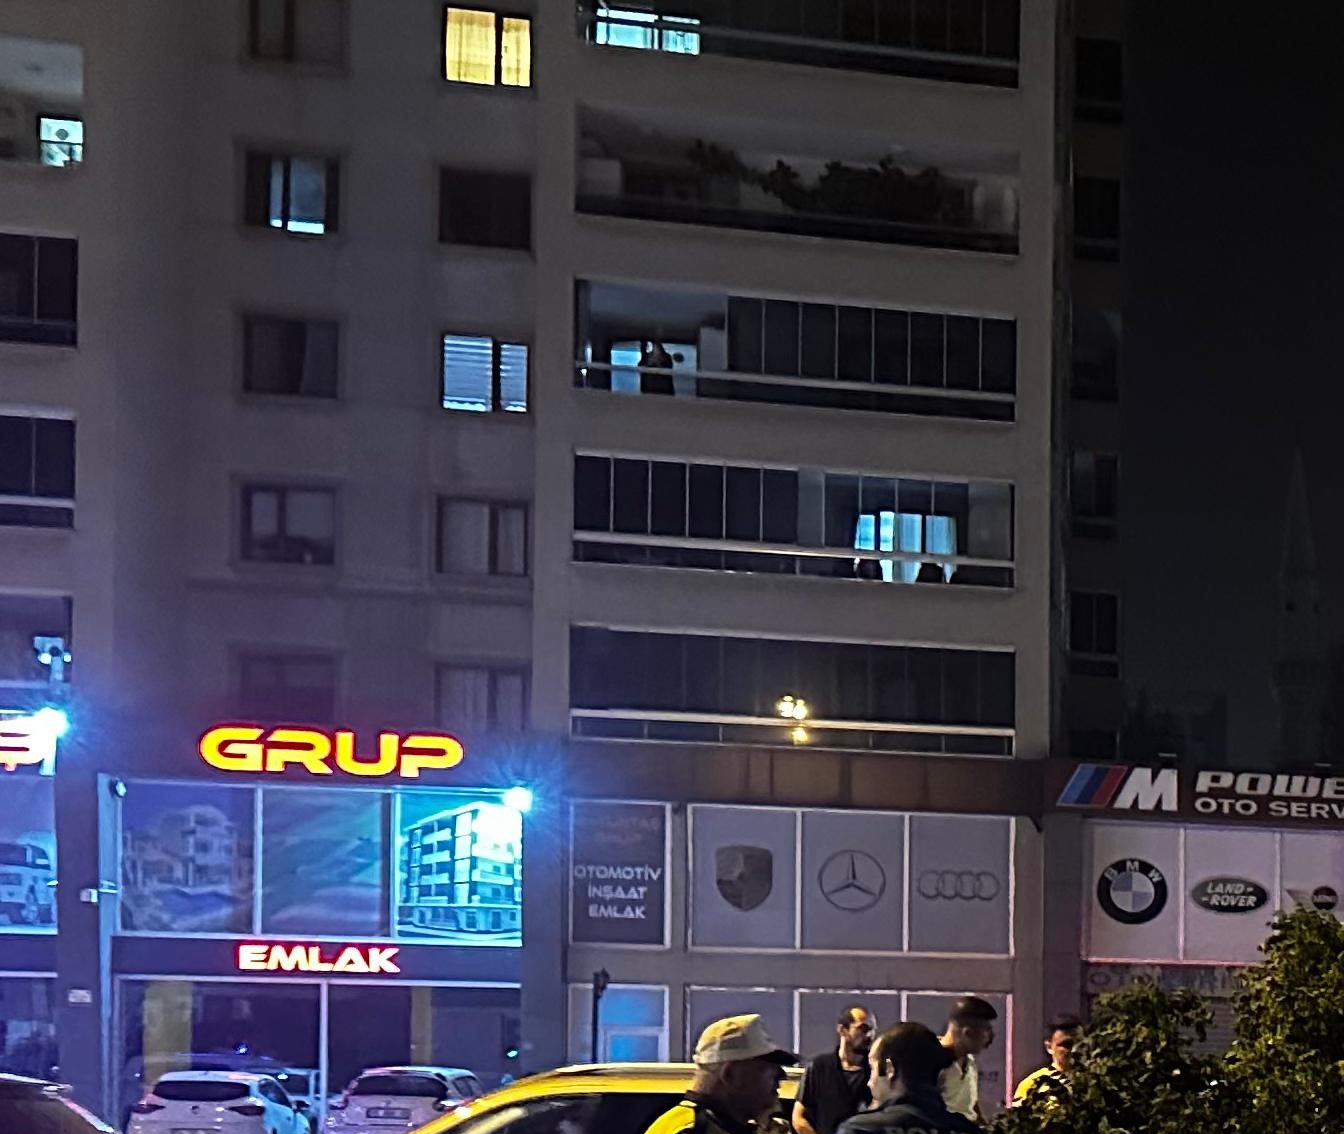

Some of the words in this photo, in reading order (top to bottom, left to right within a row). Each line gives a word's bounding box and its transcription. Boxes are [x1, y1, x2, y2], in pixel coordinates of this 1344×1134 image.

[199, 724, 464, 778] GRUP
[1114, 766, 1178, 812] M
[1194, 797, 1258, 816] OTO
[574, 864, 662, 881] OTOMOTİV
[587, 882, 648, 900] İNŞAAT
[588, 903, 647, 919] EMLAK
[238, 943, 401, 975] EMLAK
